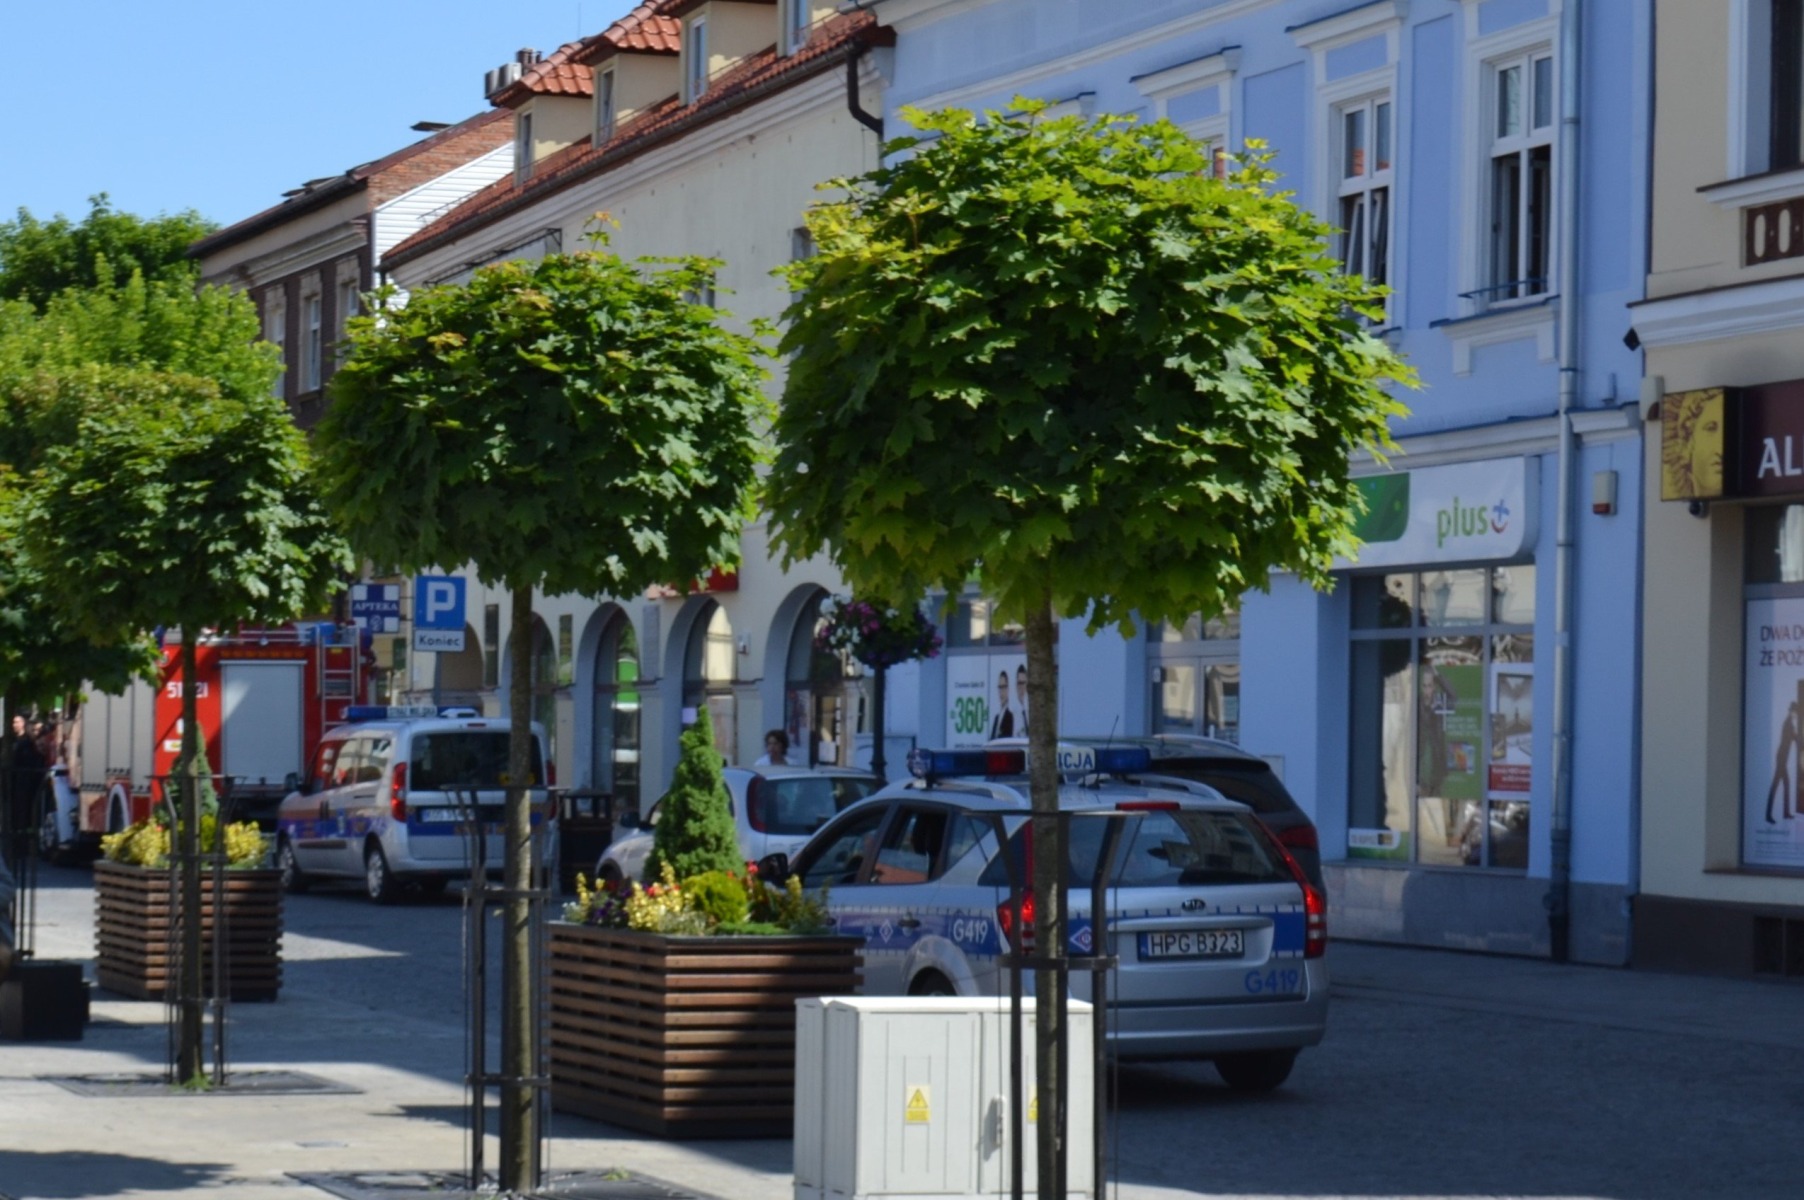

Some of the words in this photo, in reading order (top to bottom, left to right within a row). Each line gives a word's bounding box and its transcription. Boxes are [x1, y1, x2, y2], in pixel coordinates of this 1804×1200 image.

[1757, 435, 1804, 479] AL
[1437, 496, 1488, 549] plus
[353, 602, 398, 611] APTEKA
[426, 581, 456, 622] P
[420, 634, 460, 646] Koniec
[1761, 626, 1791, 641] DWA
[1760, 646, 1773, 666] ŻE
[953, 918, 989, 944] G419
[1151, 934, 1190, 954] HPG
[1197, 933, 1240, 951] B323
[1245, 970, 1299, 993] G419
